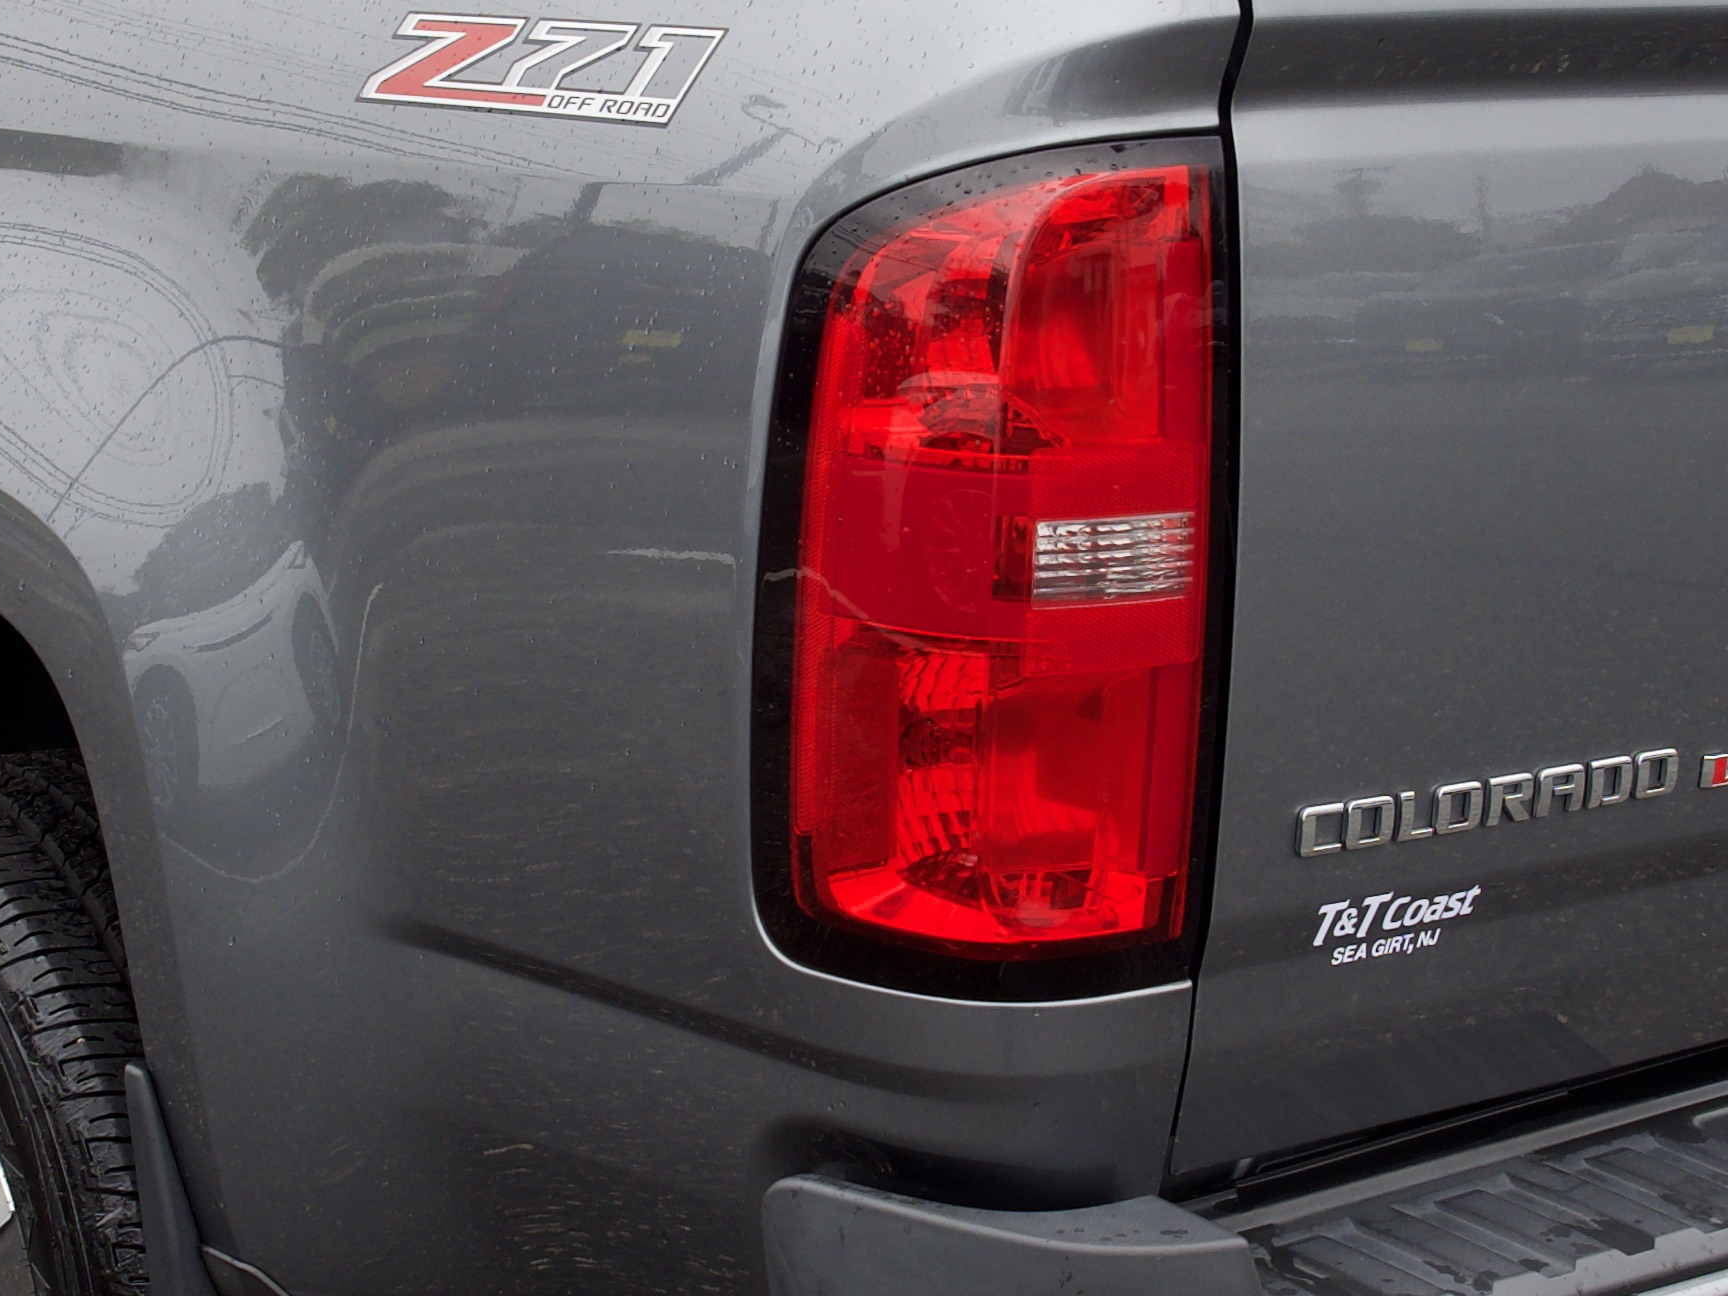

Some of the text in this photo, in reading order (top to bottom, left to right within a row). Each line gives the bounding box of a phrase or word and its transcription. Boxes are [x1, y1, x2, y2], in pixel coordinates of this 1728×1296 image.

[356, 11, 729, 116] Z71
[547, 95, 671, 120] OFF ROAD
[1297, 749, 1678, 857] COLORADO
[1312, 884, 1482, 947] T&T Coast
[1331, 928, 1440, 966] SEA GIRT, NJ
